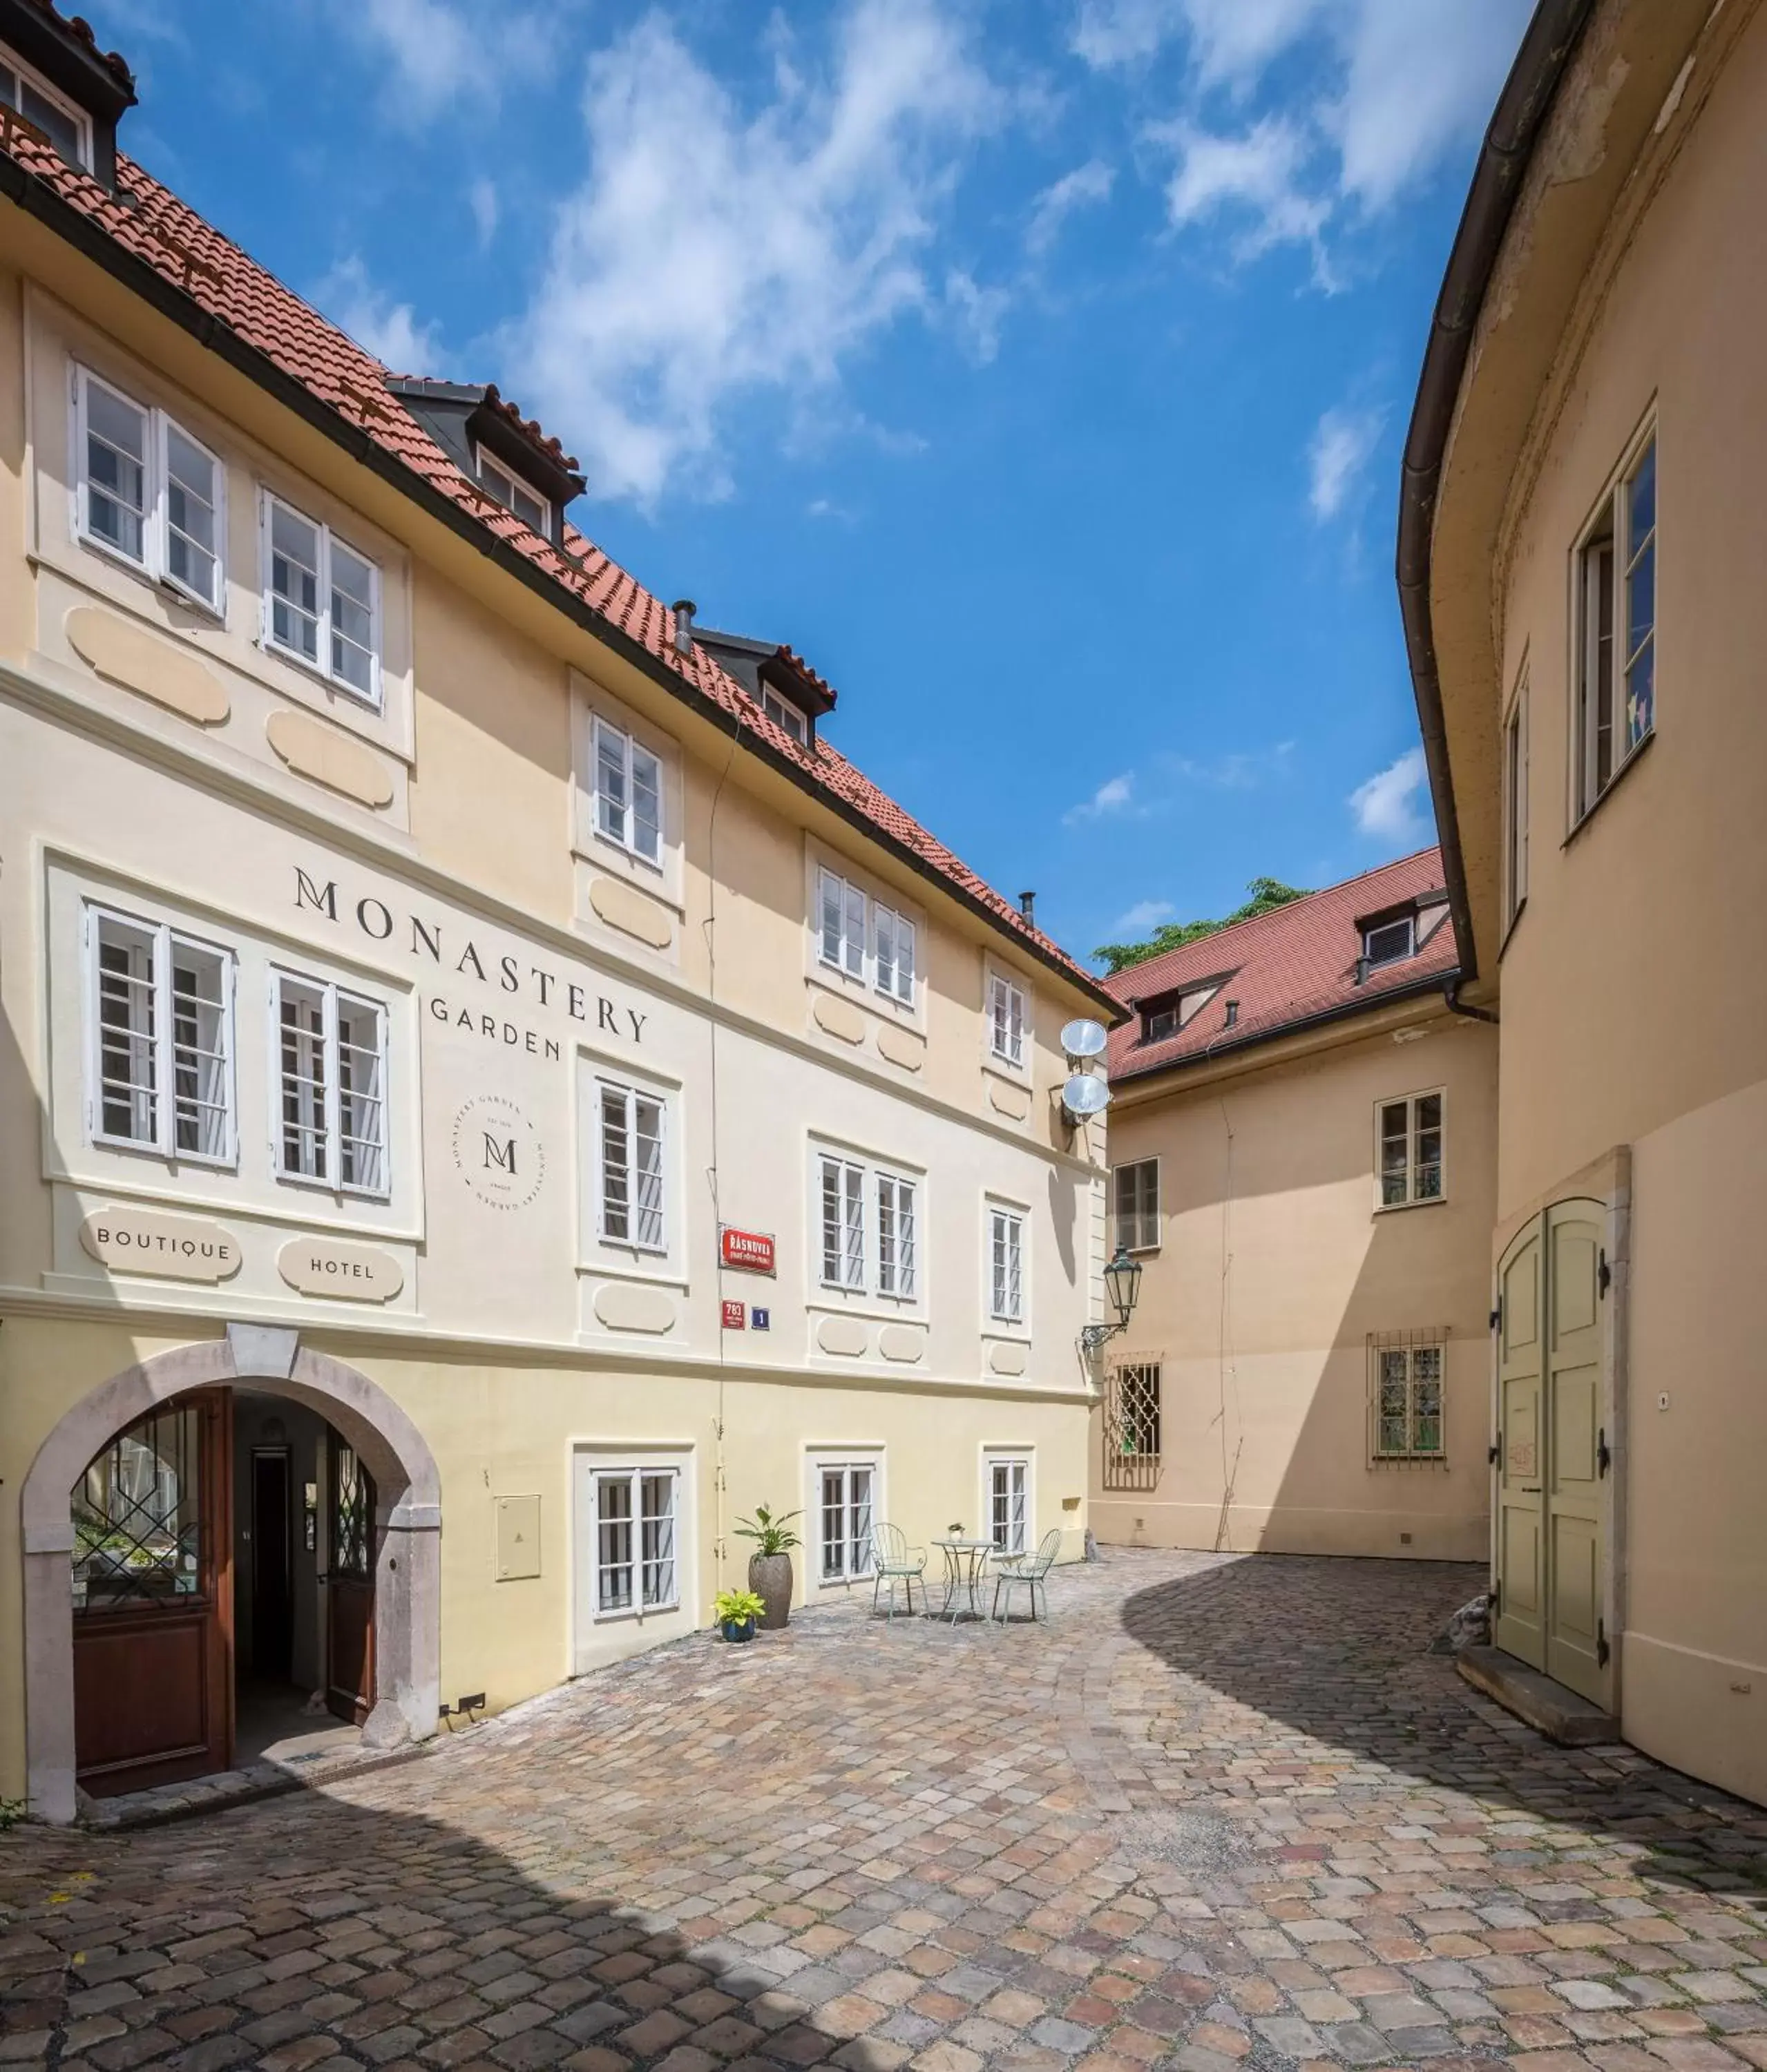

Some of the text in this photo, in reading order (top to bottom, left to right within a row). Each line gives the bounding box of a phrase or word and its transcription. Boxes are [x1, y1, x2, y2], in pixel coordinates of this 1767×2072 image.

[292, 866, 648, 1043] MONASTERY
[430, 997, 560, 1062] GARDEN
[481, 1131, 519, 1176] M
[97, 1228, 229, 1259] BOUTIQUE
[311, 1258, 374, 1278] HOTEL
[726, 1303, 741, 1316] 783
[759, 1313, 763, 1323] 1
